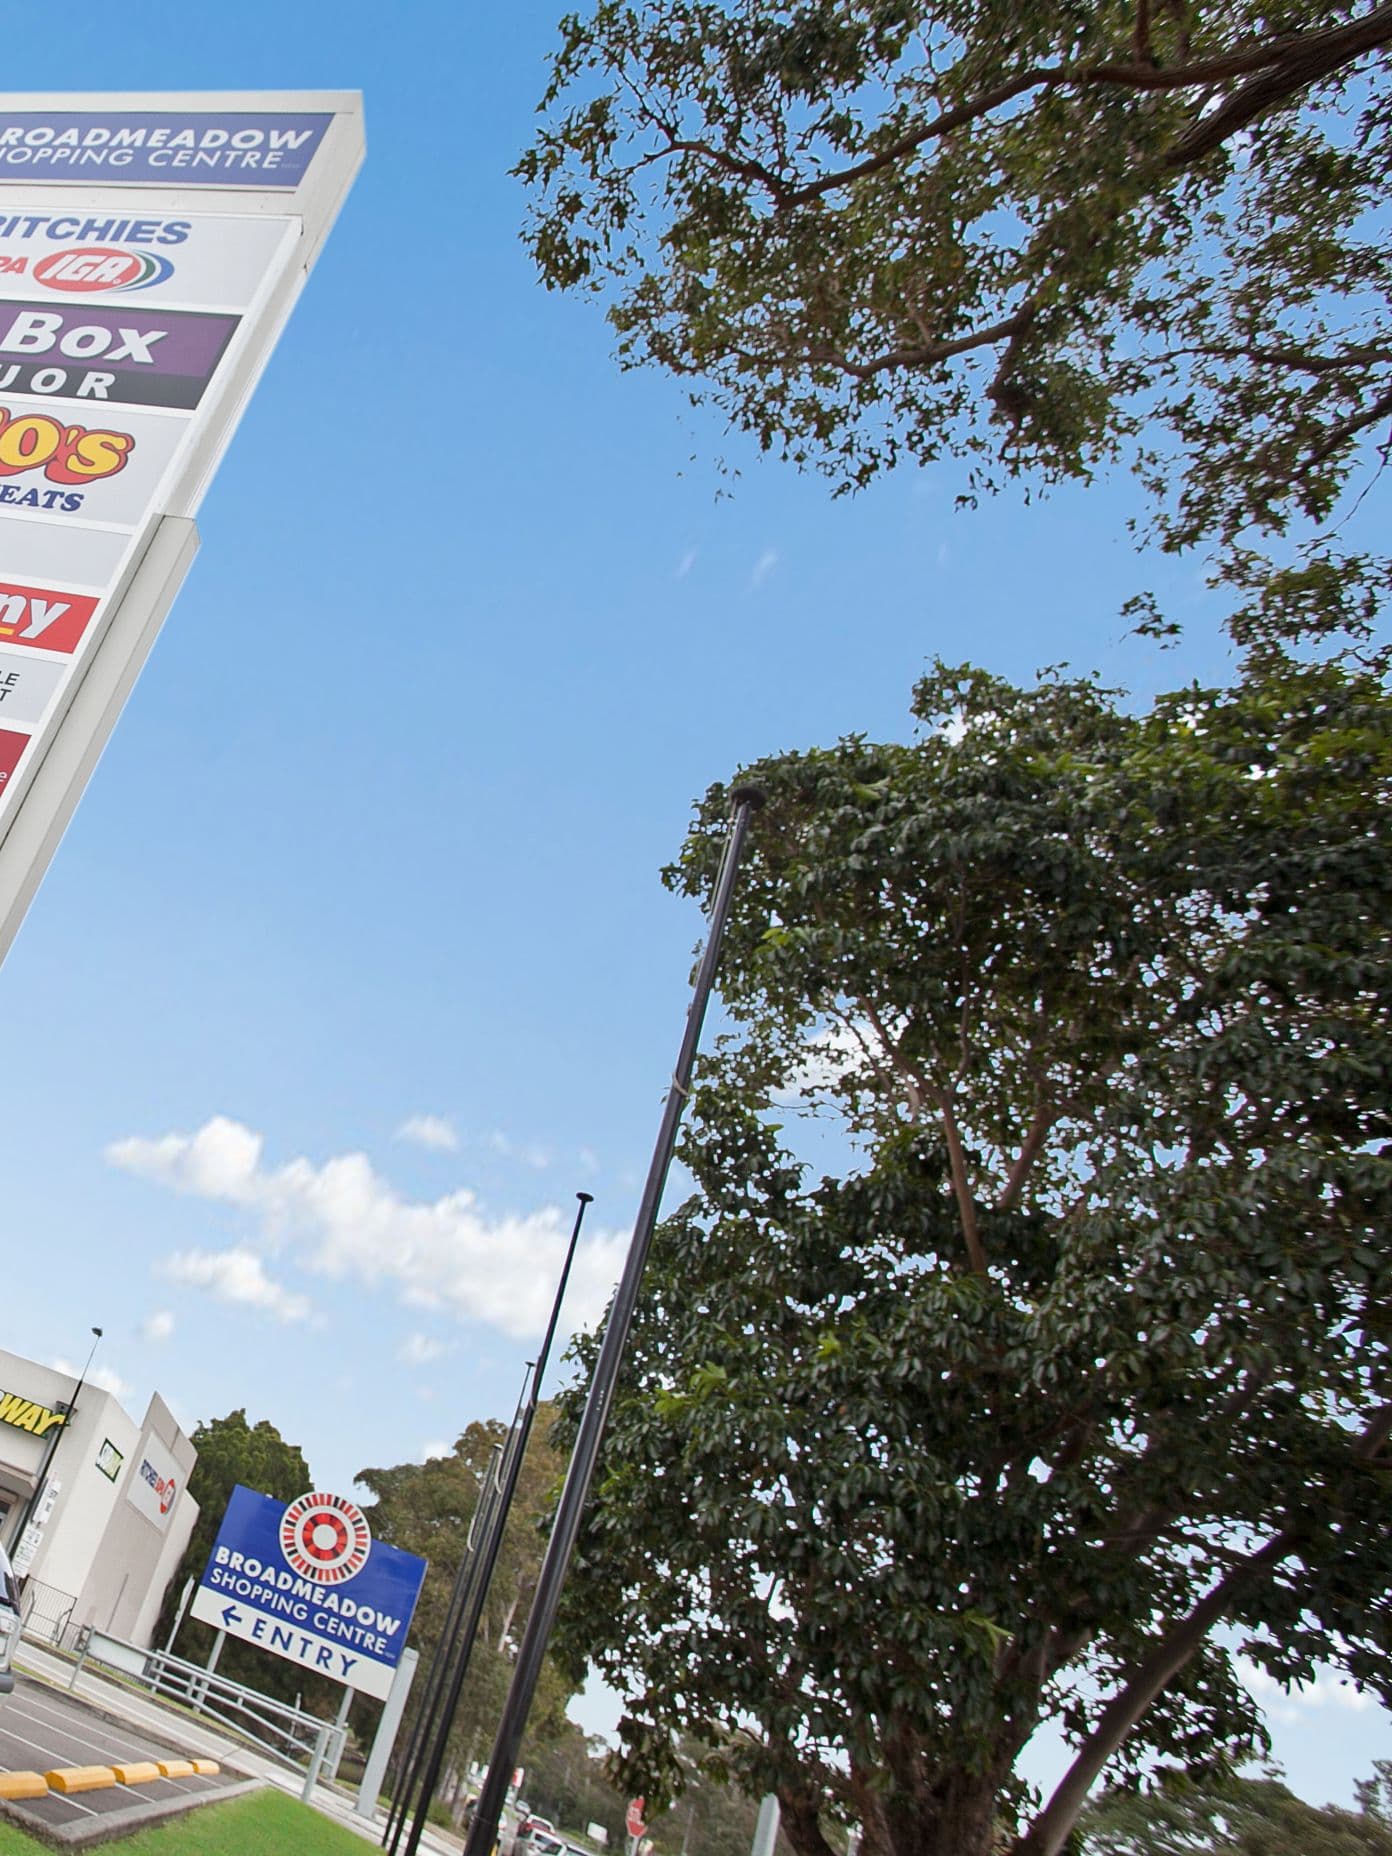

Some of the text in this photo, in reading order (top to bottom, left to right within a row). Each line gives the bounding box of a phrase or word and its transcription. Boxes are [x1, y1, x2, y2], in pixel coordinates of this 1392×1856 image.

[147, 150, 284, 169] CENTRE
[39, 253, 134, 284] IGA
[210, 1568, 387, 1655] SHOPPING CENTRE
[215, 1545, 401, 1637] BROADMEADOW
[250, 1618, 358, 1677] ENTRY
